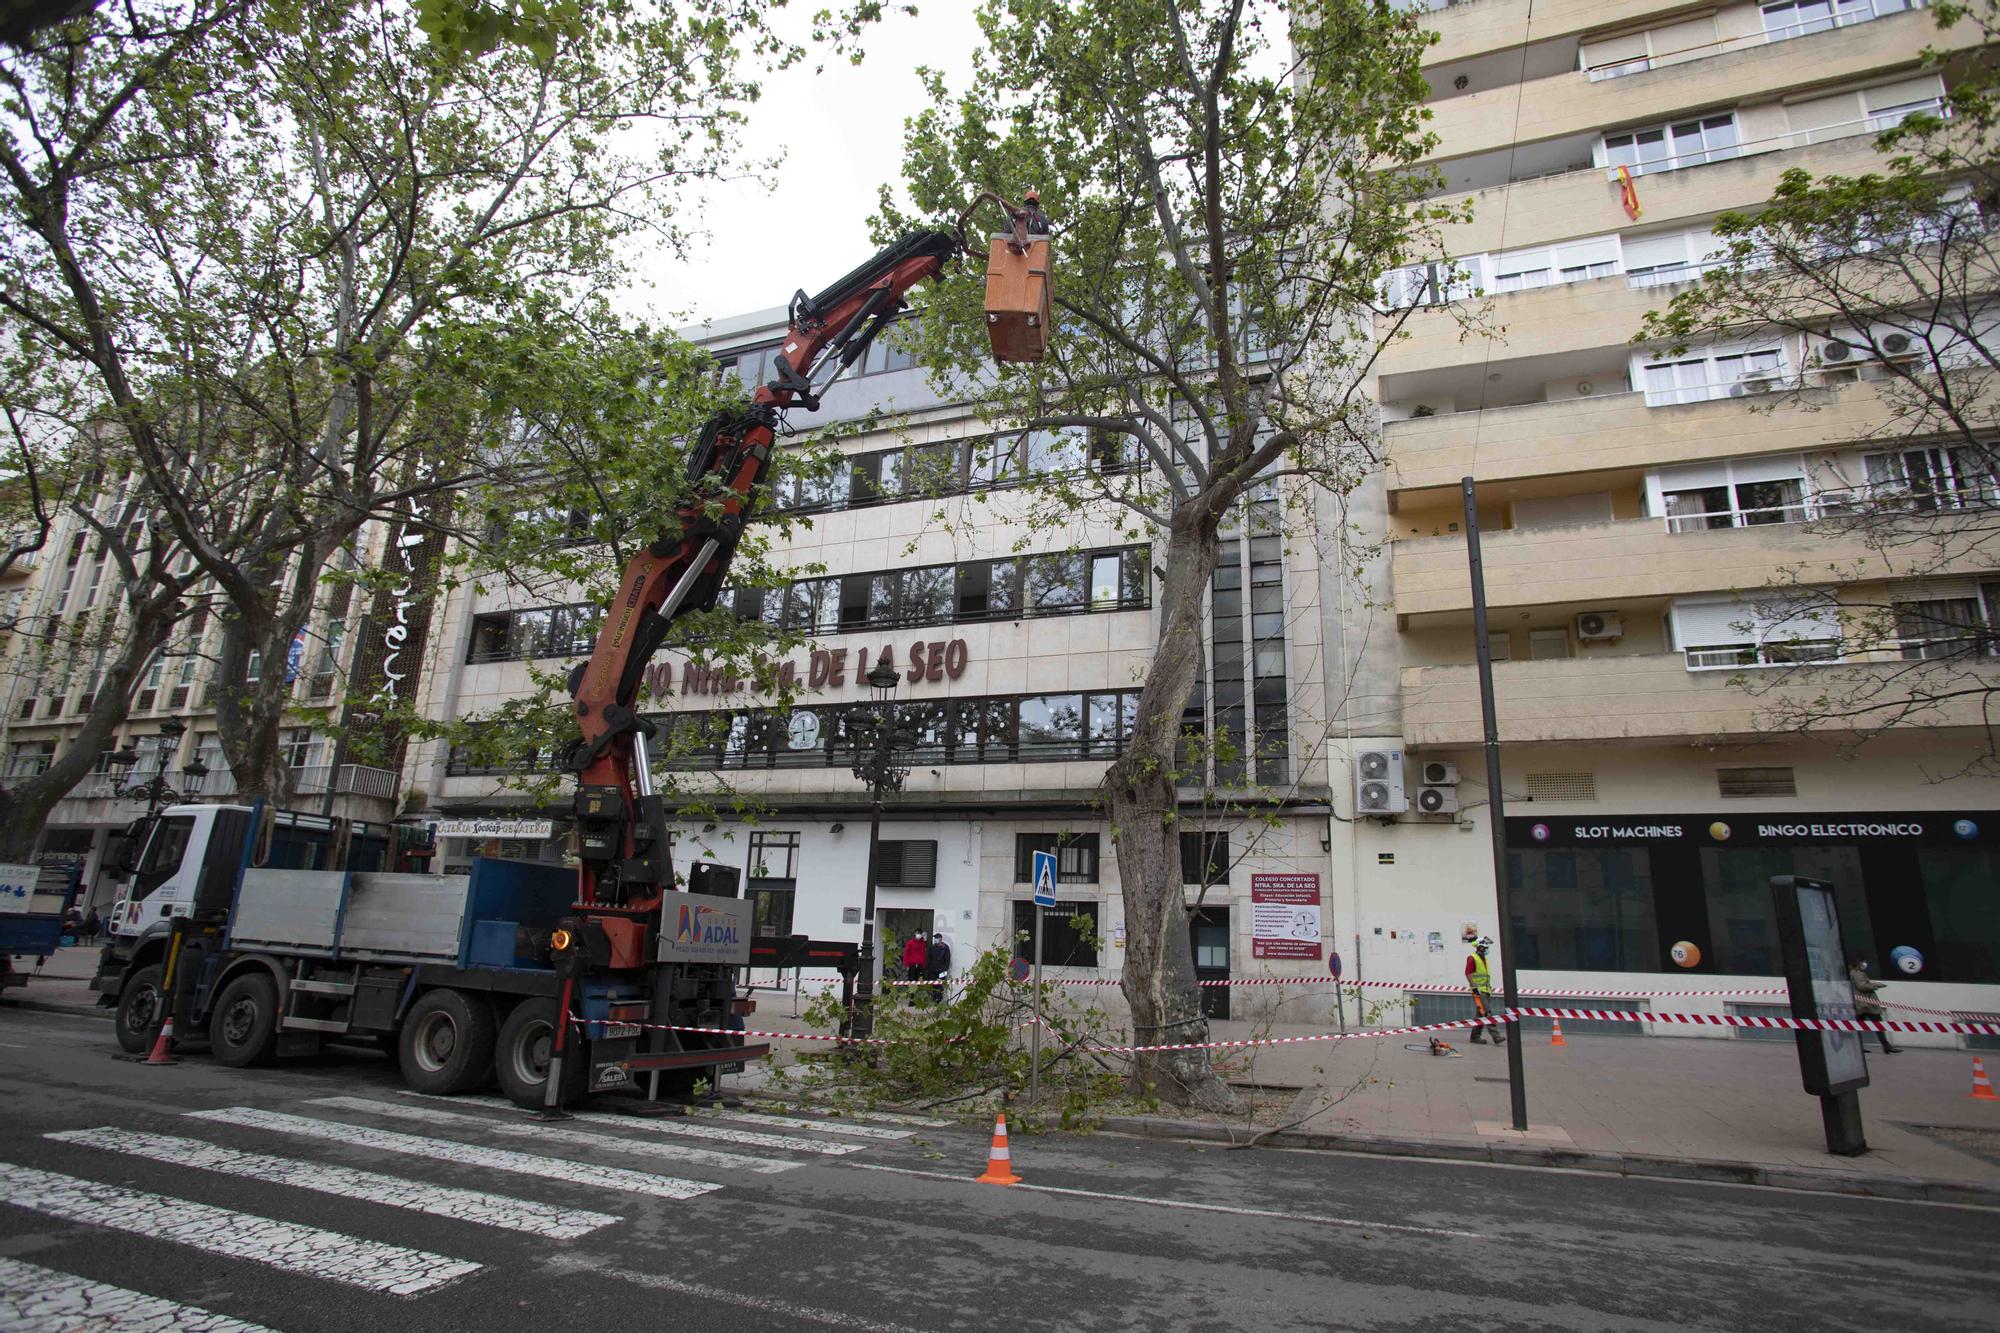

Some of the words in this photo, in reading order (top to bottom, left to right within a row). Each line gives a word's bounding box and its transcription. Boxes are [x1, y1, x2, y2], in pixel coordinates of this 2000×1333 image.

[809, 648, 848, 688] DE
[907, 638, 967, 682] SEO
[502, 824, 550, 834] GELATERIA
[1575, 826, 1609, 838] SLOT
[1613, 825, 1682, 838] MACHINES
[1757, 824, 1808, 837] BINGO
[1811, 823, 1922, 837] ELECTRONICO
[703, 926, 739, 944] ADAL
[1907, 961, 1916, 970] 2
